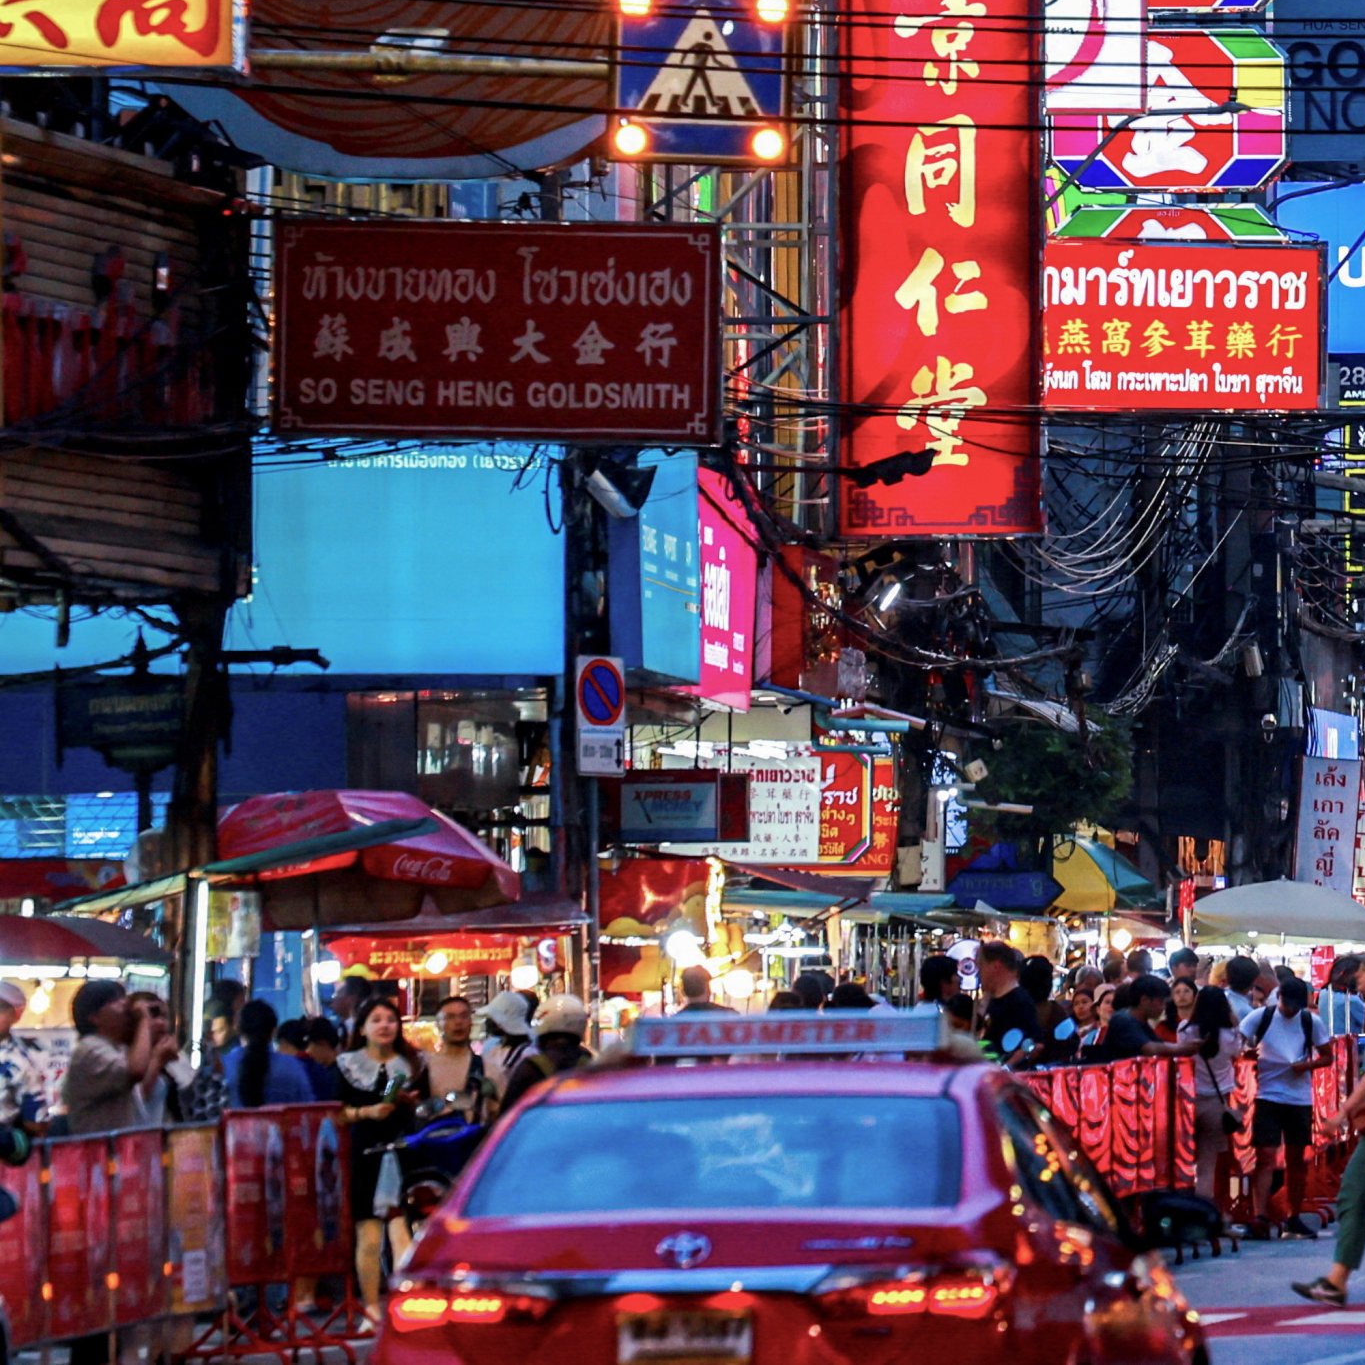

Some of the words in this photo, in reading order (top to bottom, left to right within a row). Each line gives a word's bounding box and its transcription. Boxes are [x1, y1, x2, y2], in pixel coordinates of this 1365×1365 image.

[1302, 20, 1333, 31] HUA
[302, 251, 498, 306] ห้างขายทอง
[1044, 317, 1303, 359] 燕窩參茸藥行
[299, 377, 338, 407] SO
[350, 378, 426, 408] SENG
[436, 380, 516, 409] HENG
[526, 381, 693, 412] GOLDSMITH
[1117, 368, 1209, 393] กระเพาะปลา
